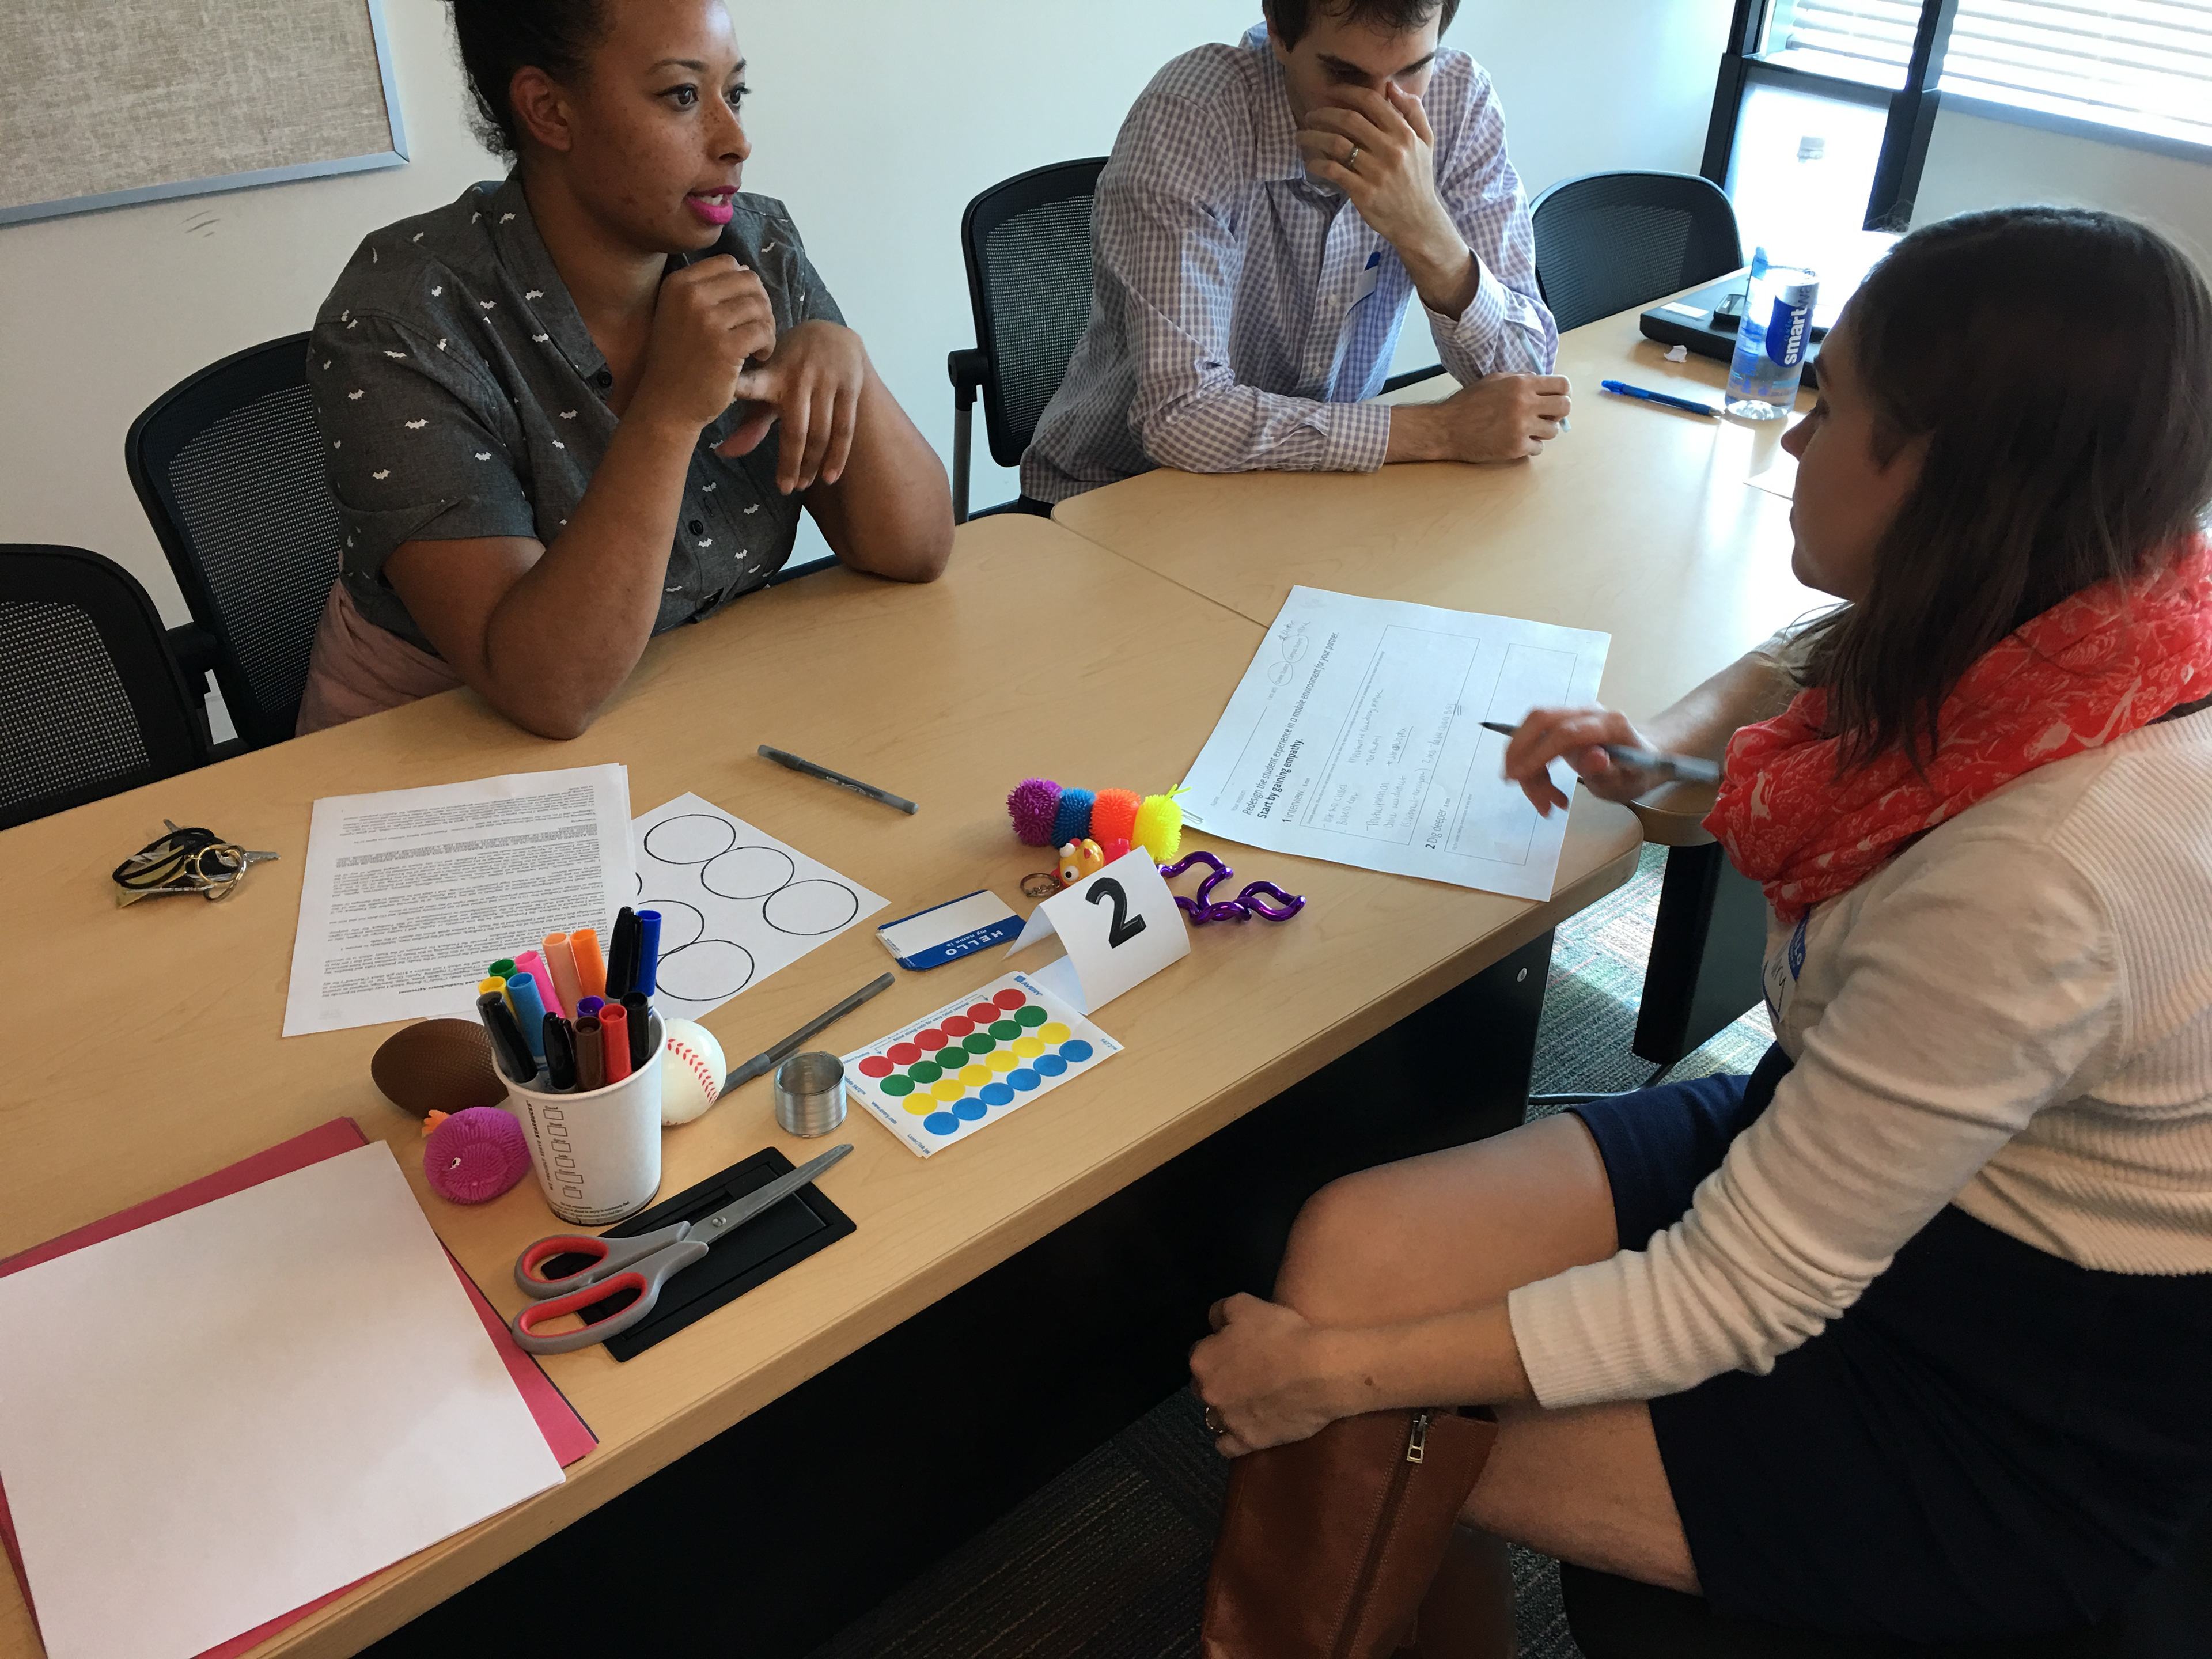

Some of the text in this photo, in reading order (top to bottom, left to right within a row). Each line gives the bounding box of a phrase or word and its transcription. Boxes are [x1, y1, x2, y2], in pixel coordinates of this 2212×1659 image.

[1287, 648, 1297, 660] Campus
[1273, 663, 1291, 684] Online Student
[1242, 789, 1263, 815] Redesign
[1256, 779, 1267, 789] the
[1262, 757, 1278, 779] student
[1272, 728, 1292, 757] experience
[1292, 699, 1306, 717] mobile
[1301, 668, 1321, 699] environment
[1313, 660, 1325, 670] for
[1320, 649, 1330, 662] your
[1325, 632, 1339, 650] partner.
[1257, 738, 1304, 818] Start by gaining empathy.
[1284, 790, 1305, 817] Interview.
[1426, 832, 1442, 843] Dig
[1085, 877, 1147, 948] 2
[945, 930, 1004, 955] HELLO
[955, 934, 975, 944] name
[872, 1101, 897, 1124] www.avery.com
[537, 1139, 545, 1157] SERVE
